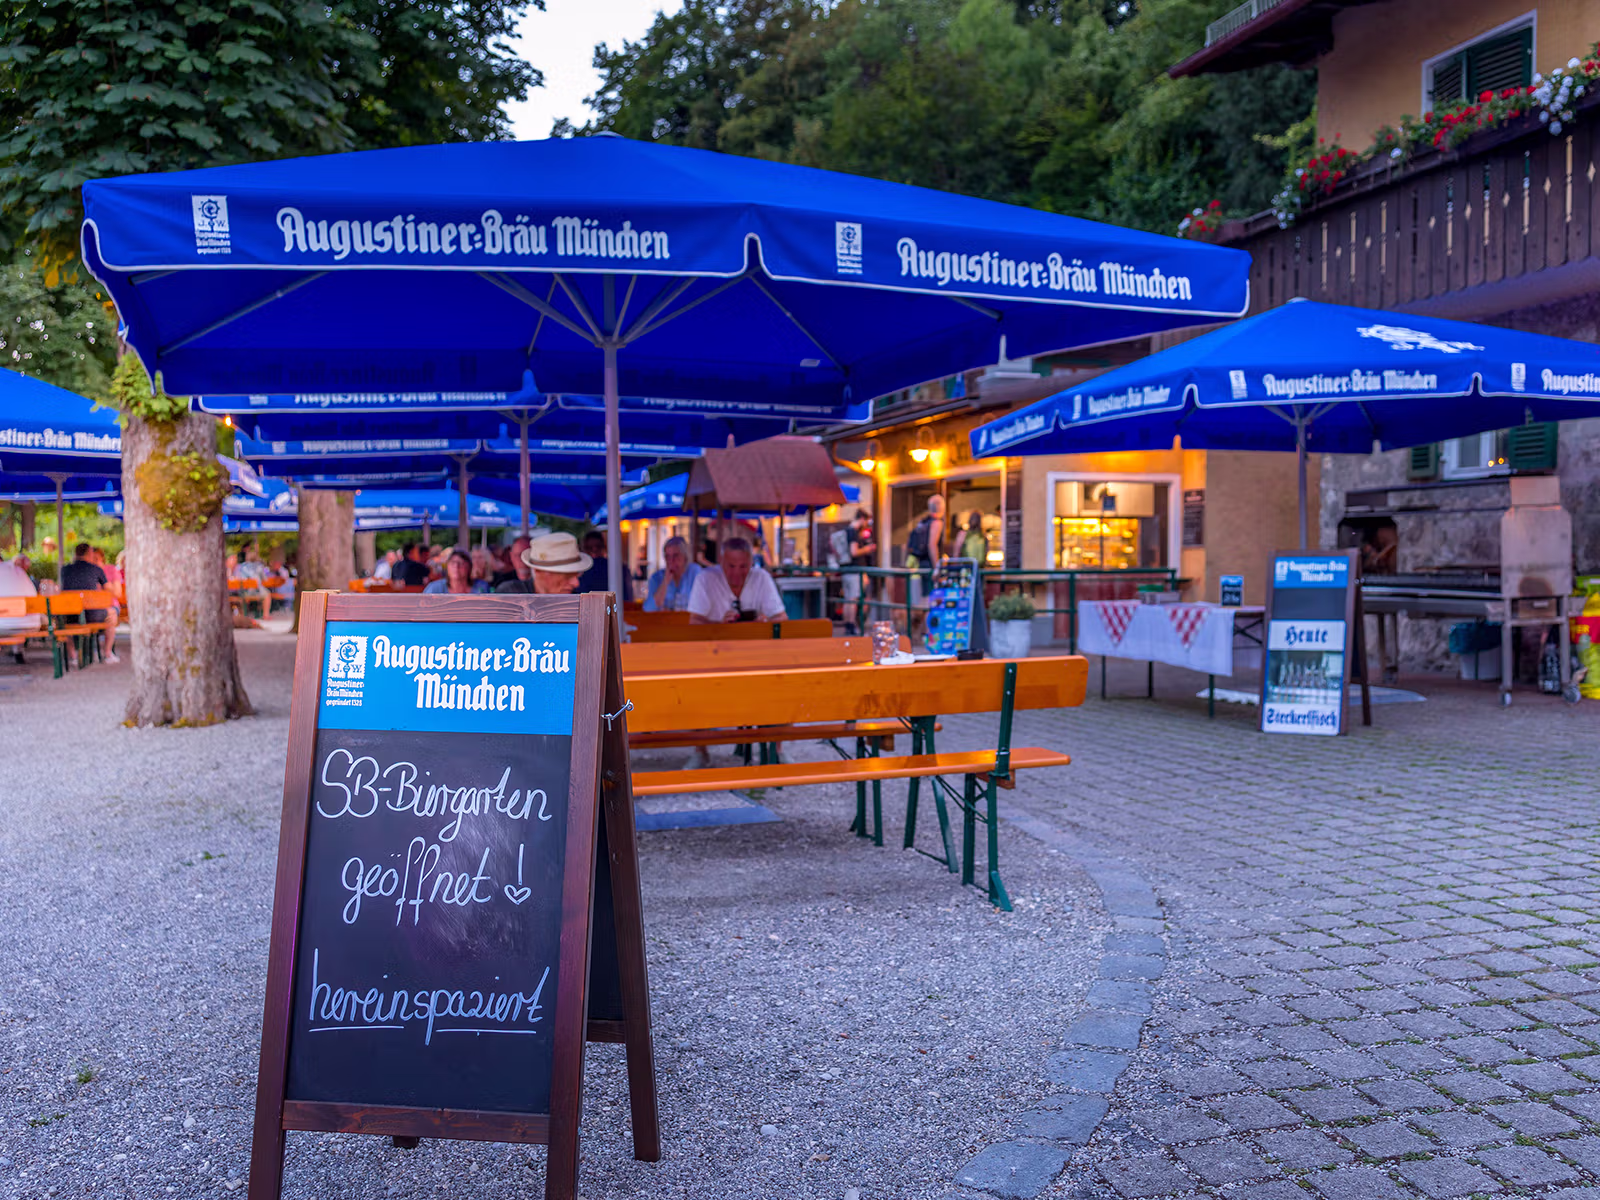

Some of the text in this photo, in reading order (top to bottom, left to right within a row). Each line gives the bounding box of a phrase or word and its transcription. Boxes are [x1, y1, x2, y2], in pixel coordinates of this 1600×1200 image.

[552, 217, 670, 259] München
[1100, 261, 1193, 301] München
[1285, 626, 1329, 645] Heute
[413, 673, 526, 712] München
[316, 748, 552, 842] SB-Biergarten
[309, 948, 550, 1046] hereinspaziert
